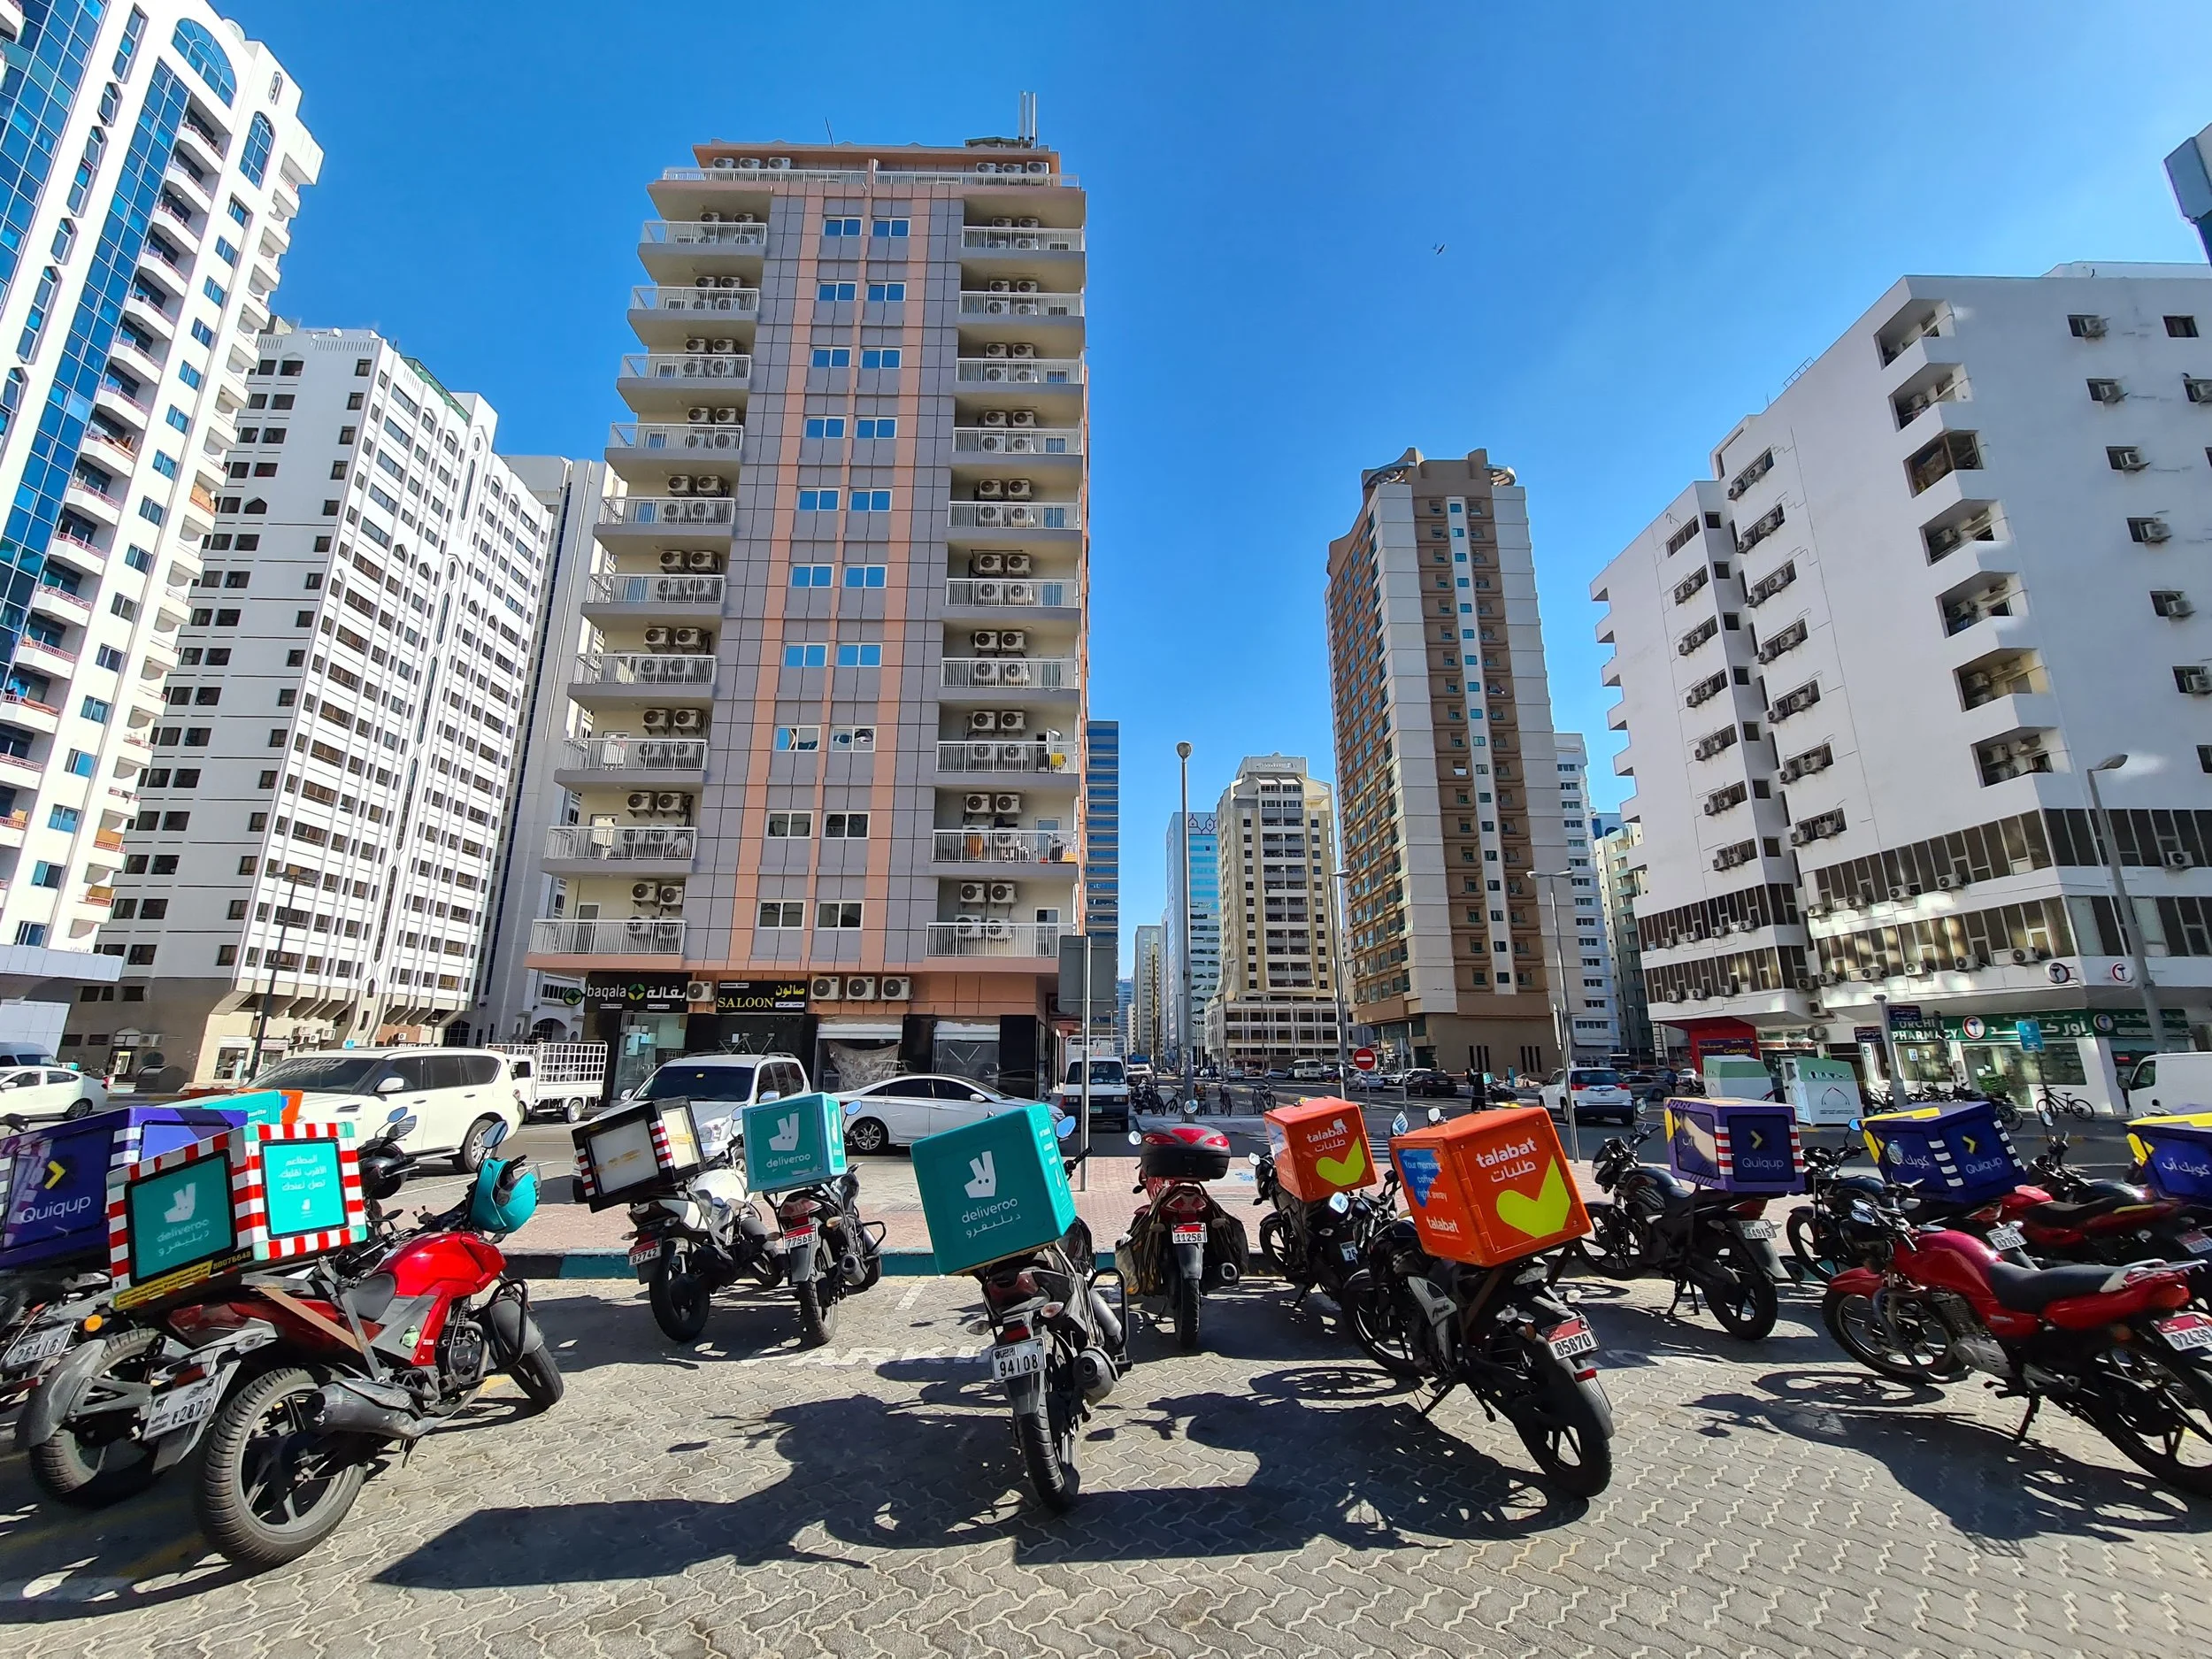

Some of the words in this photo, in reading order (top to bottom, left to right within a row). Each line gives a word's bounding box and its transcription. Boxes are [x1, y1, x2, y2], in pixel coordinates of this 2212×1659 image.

[587, 983, 626, 1001] baqala
[646, 985, 686, 1002] بقالة
[775, 984, 805, 998] صالون
[718, 996, 774, 1008] SALOON
[1306, 1125, 1348, 1142] talabat
[1315, 1138, 1346, 1152] طلبات
[1476, 1137, 1537, 1168] talabat
[766, 1154, 811, 1168] deliveroo
[1417, 1160, 1442, 1173] morning
[1742, 1157, 1785, 1170] Quiqup
[1966, 1156, 2003, 1174] Quiqup
[1491, 1159, 1537, 1183] طلبات
[1417, 1188, 1431, 1201] right
[1431, 1192, 1448, 1202] away
[20, 1195, 91, 1224] Quiqup
[962, 1198, 1018, 1223] deliveroo
[157, 1219, 209, 1242] deliveroo
[965, 1213, 1021, 1239] ديليفرو
[1425, 1216, 1459, 1233] talabat
[1554, 1333, 1592, 1356] 85870
[999, 1354, 1039, 1378] 94108
